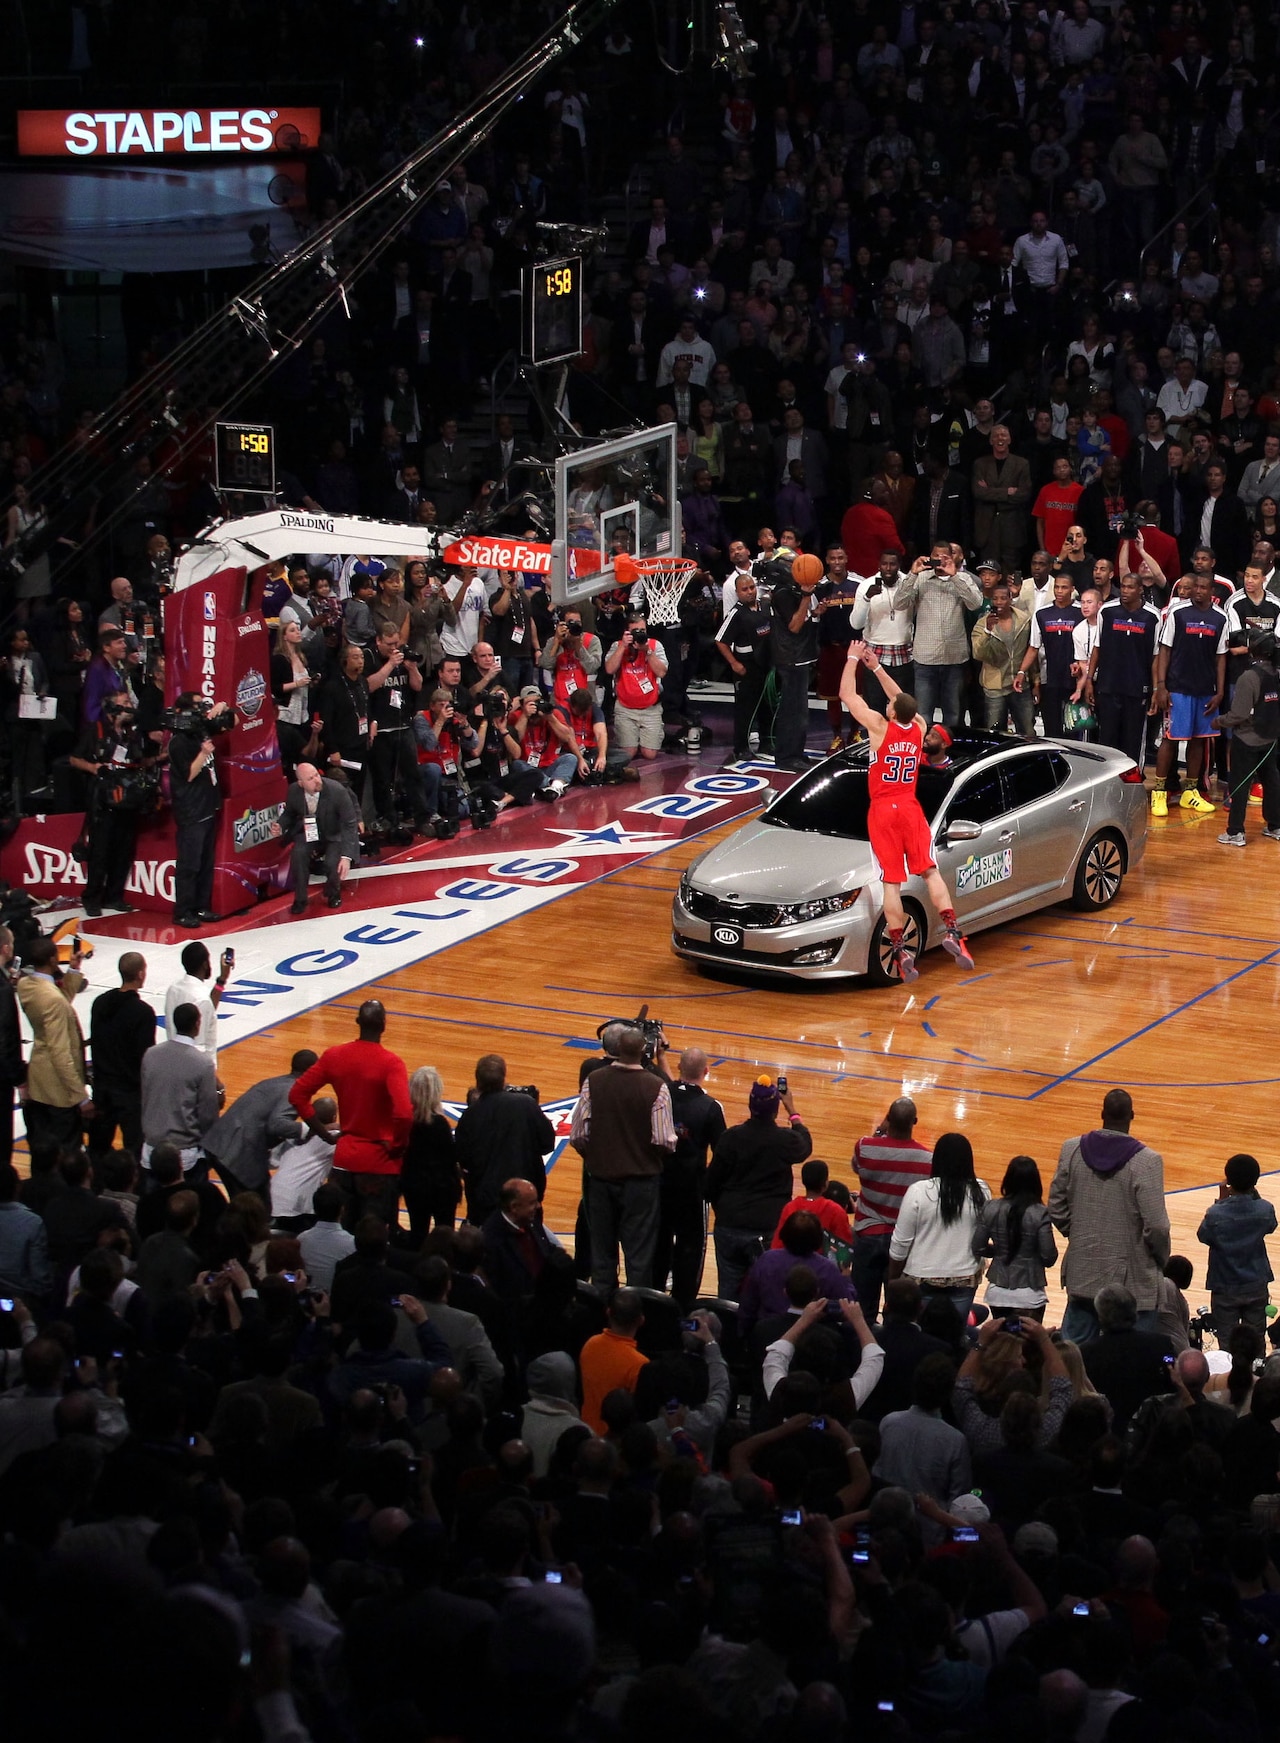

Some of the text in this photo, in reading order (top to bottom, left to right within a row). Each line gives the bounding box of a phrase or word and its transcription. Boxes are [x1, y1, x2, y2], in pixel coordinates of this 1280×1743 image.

[546, 268, 572, 297] 1:58
[240, 433, 269, 453] 1:58
[280, 513, 335, 533] SPALDING
[458, 540, 511, 568] State
[888, 742, 918, 755] GRIFFIN
[882, 755, 917, 783] 32
[237, 814, 256, 842] Sprite
[252, 824, 273, 844] DUN
[24, 842, 177, 903] SPANG
[958, 859, 980, 887] Sprite
[983, 852, 1004, 871] SLAM
[975, 865, 1003, 889] DUNK
[718, 930, 736, 942] KIA
